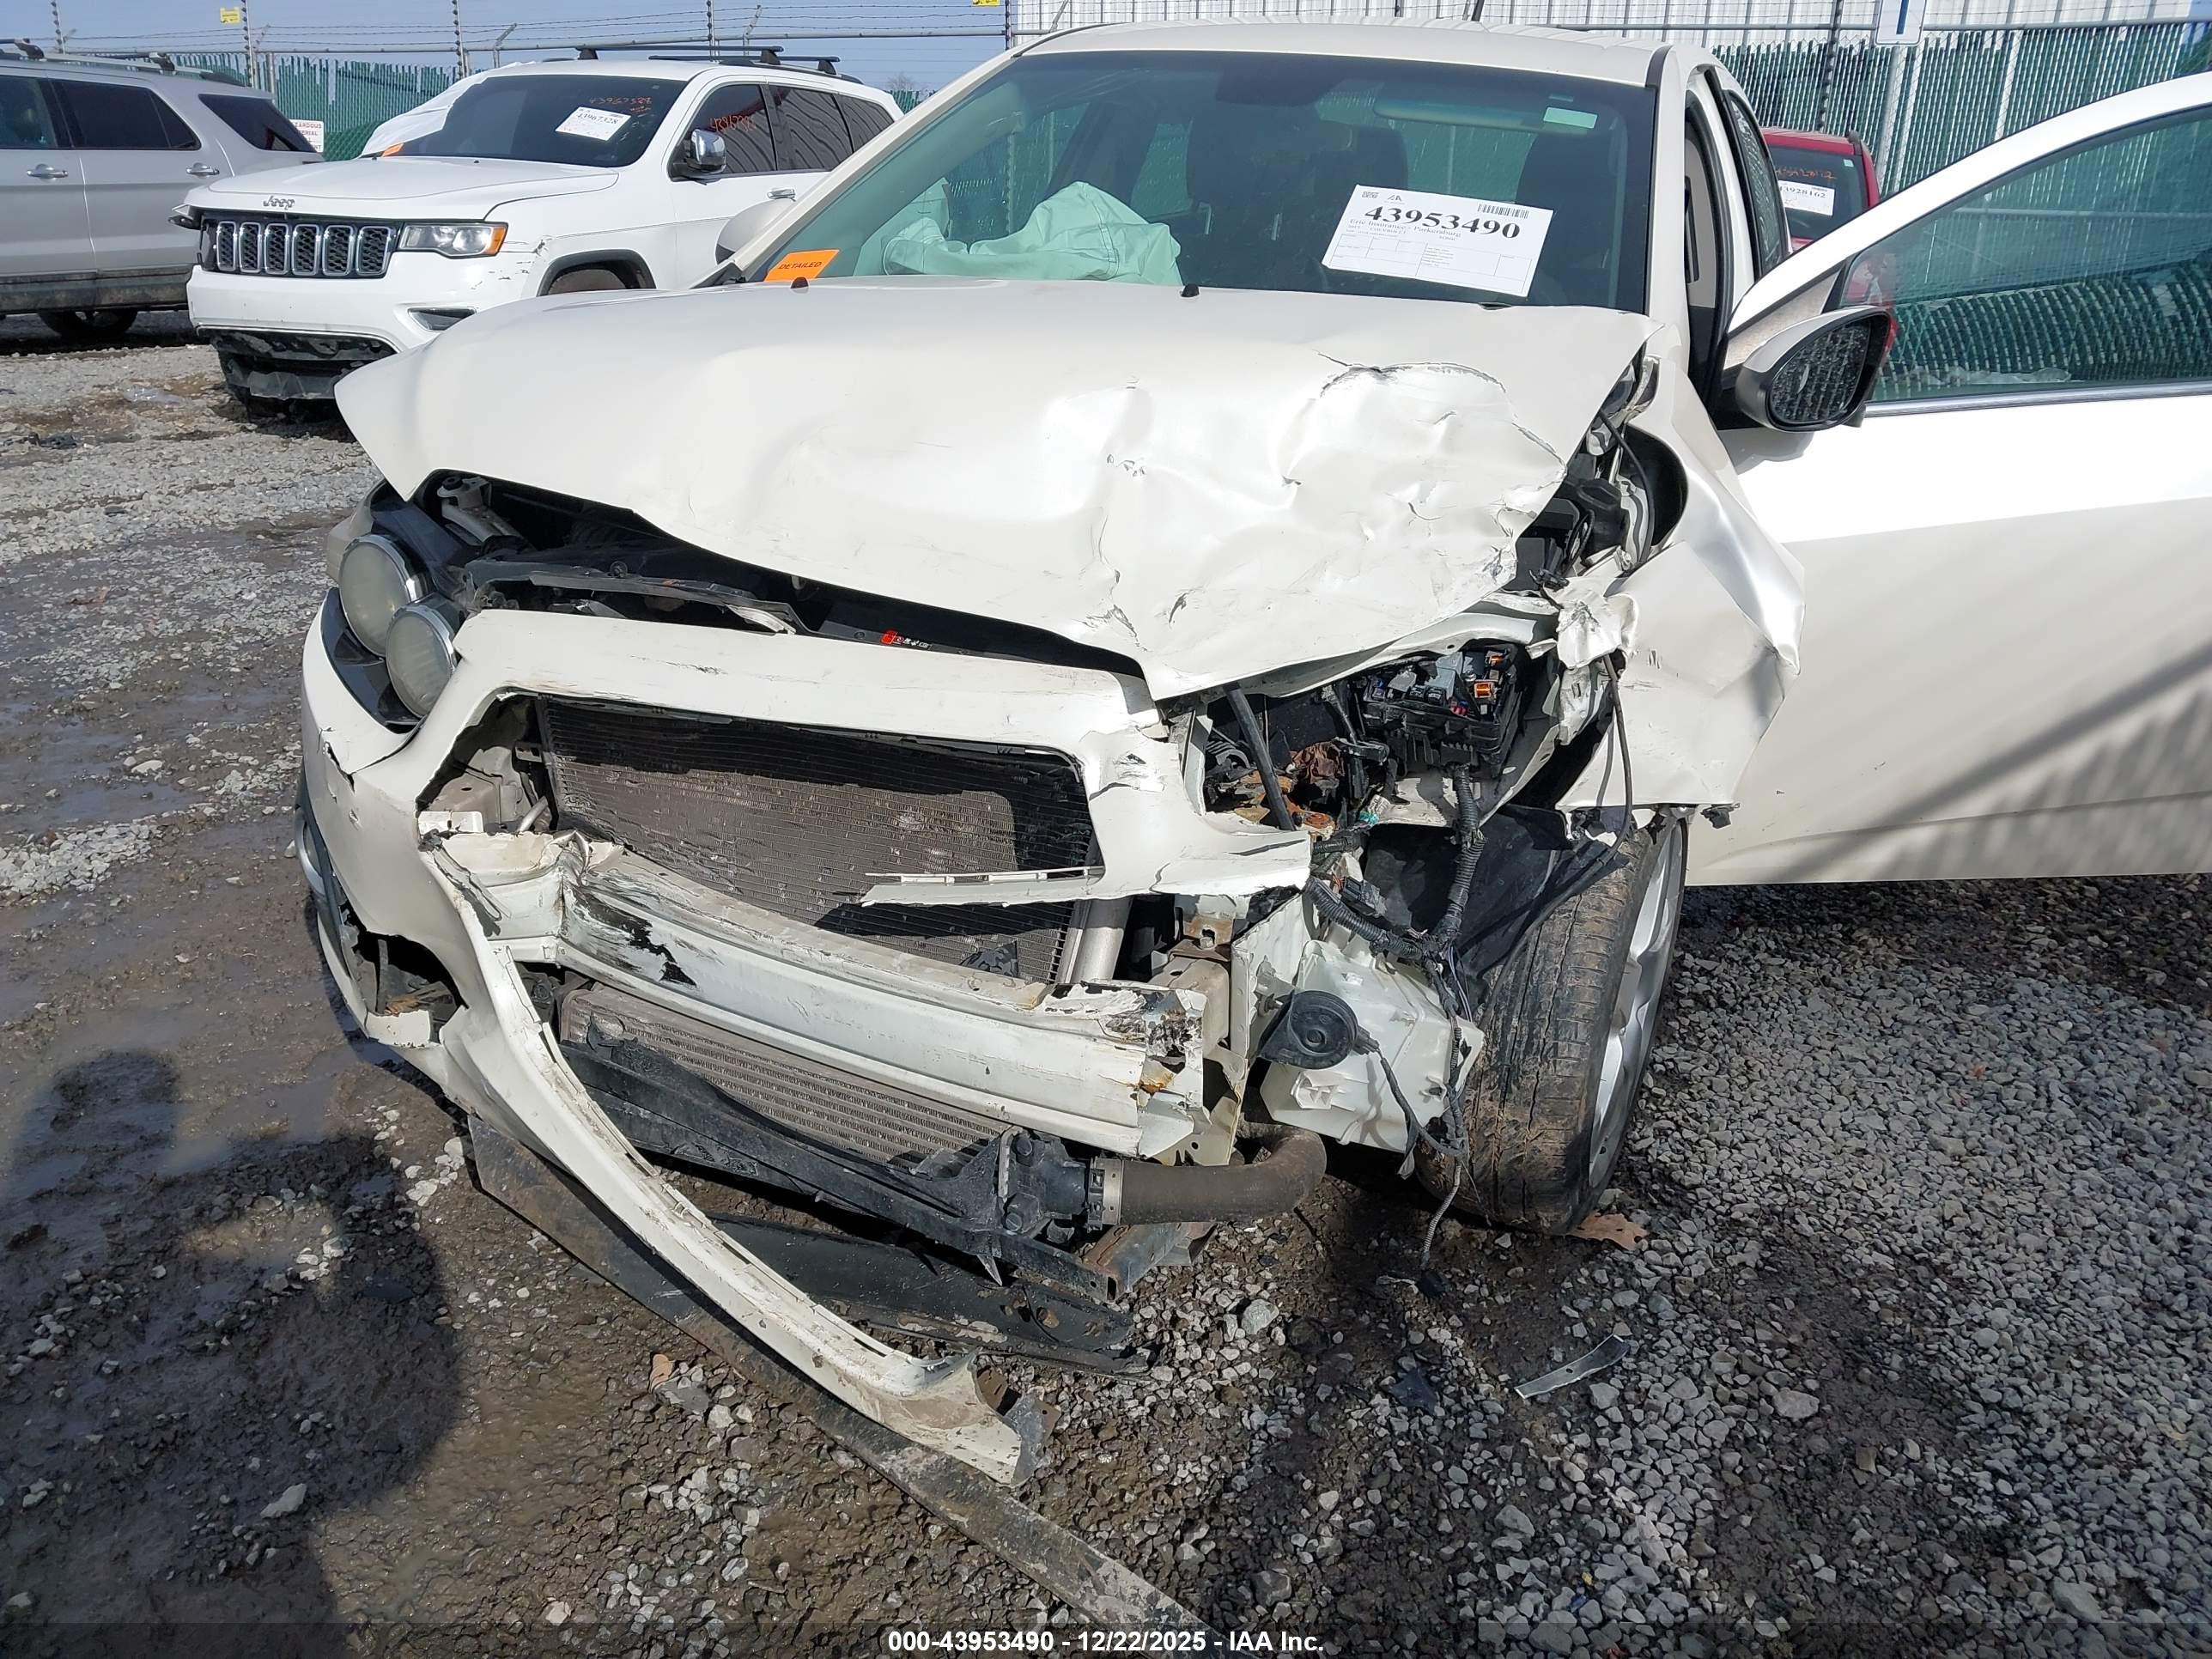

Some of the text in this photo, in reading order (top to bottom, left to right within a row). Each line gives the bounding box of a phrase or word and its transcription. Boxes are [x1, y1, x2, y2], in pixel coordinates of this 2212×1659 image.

[263, 195, 295, 210] Jeep
[1364, 205, 1521, 240] 43953490
[1368, 220, 1407, 230] Insurance
[1413, 226, 1462, 238] Parkersburg
[778, 261, 823, 270] DETAILED
